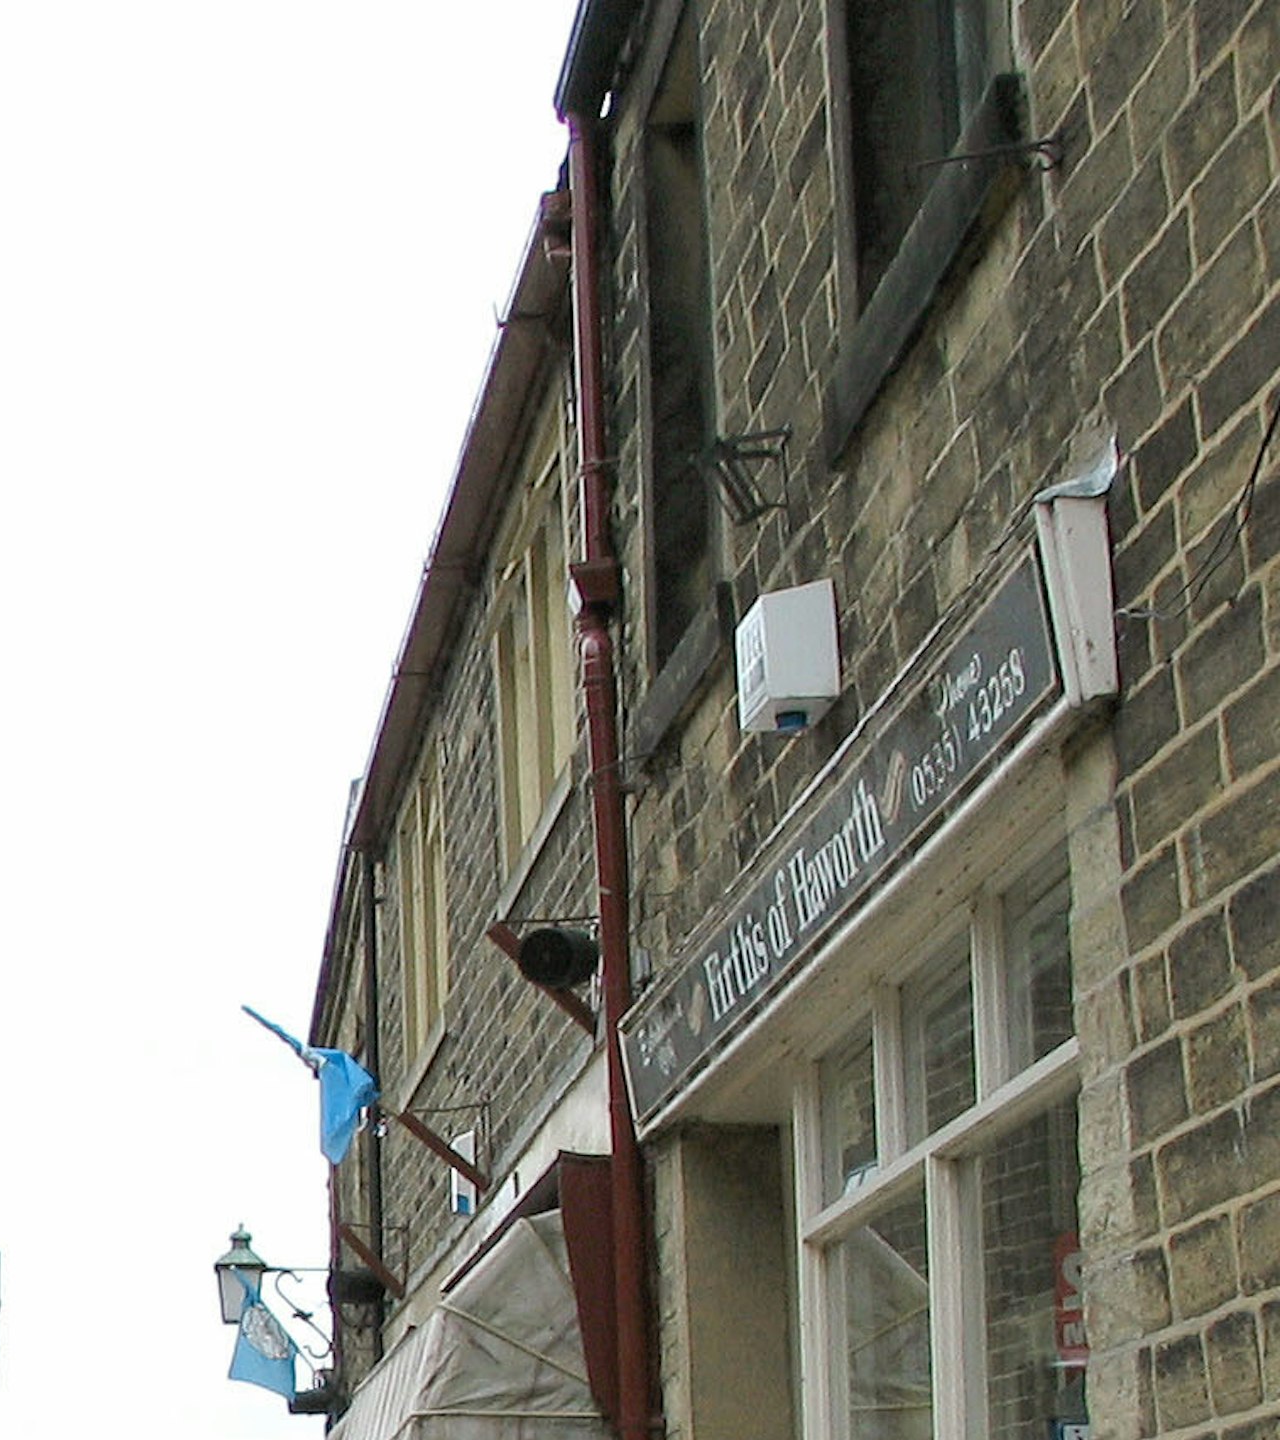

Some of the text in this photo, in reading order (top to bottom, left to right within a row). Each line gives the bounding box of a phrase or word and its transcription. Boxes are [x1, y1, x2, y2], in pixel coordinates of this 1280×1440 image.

[968, 648, 1025, 741] 43258
[703, 778, 886, 1023] Firth's of Haworth
